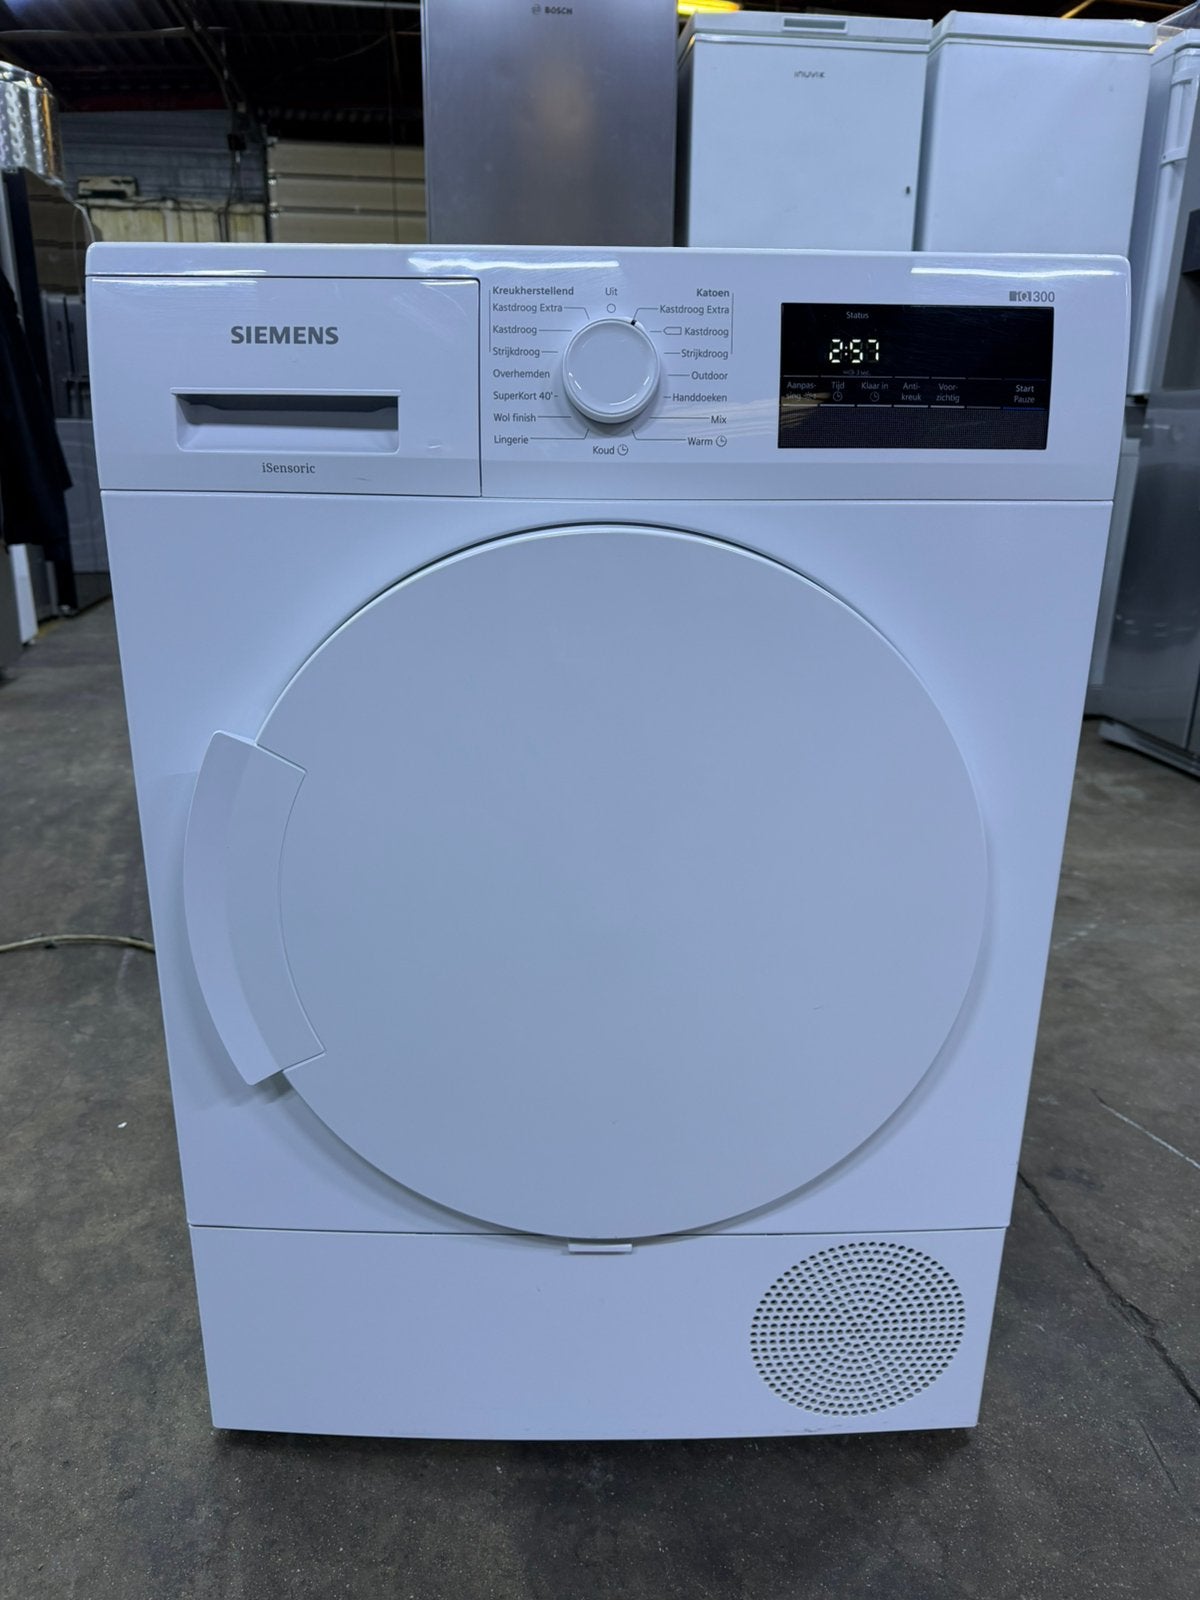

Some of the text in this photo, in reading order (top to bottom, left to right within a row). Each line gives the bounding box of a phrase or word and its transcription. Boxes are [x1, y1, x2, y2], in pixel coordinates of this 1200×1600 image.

[544, 6, 573, 15] BOSCH
[492, 286, 574, 297] Kreukherstellend
[605, 287, 618, 297] Uit
[696, 288, 730, 298] Katoen
[492, 303, 563, 314] Kastdroog Extra
[659, 304, 730, 316] Kastdroog Extra
[846, 311, 869, 320] Status
[230, 326, 339, 345] SIEMENS
[492, 325, 538, 336] Kastdroog
[684, 326, 729, 338] Kastdroog
[492, 346, 541, 358] Strijkdroog
[681, 348, 729, 361] Strijkdroog
[829, 338, 880, 364] 2:57
[492, 368, 550, 379] Overhemden
[691, 370, 728, 381] Outdoor
[831, 381, 845, 391] Tijd
[861, 381, 889, 390] Klaar in
[902, 382, 921, 391] Anti-
[938, 383, 959, 392] Voor-
[1015, 384, 1035, 393] Start
[493, 391, 537, 403] SuperKort
[672, 393, 728, 403] Handdoeken
[901, 392, 922, 402] kreuk
[936, 393, 960, 404] zichtig
[1013, 395, 1036, 404] Pauze
[493, 412, 537, 422] Wol finish
[710, 415, 727, 424] Mix
[493, 435, 529, 446] Lingerie
[687, 436, 713, 446] Warm
[592, 445, 615, 455] Koud
[262, 462, 316, 474] iSensoric
